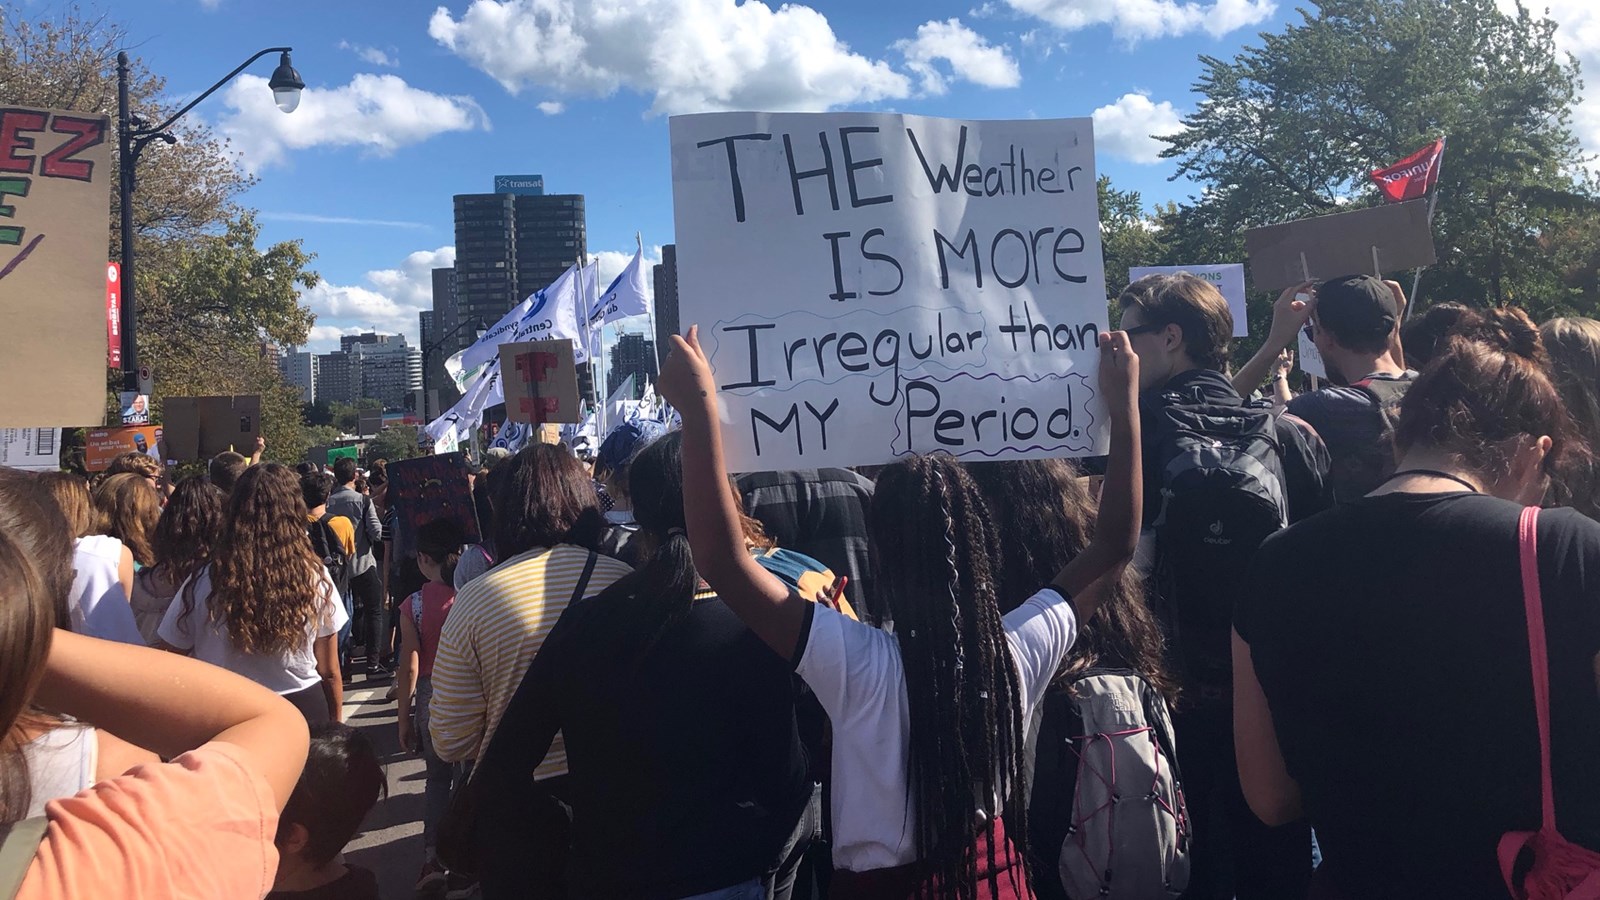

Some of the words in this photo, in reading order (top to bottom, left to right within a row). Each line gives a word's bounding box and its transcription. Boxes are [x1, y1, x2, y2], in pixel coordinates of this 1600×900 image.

[510, 180, 542, 188] transat
[697, 126, 893, 222] THE
[906, 125, 1082, 197] Weather
[823, 228, 904, 301] IS
[721, 311, 983, 406] Irregular
[999, 301, 1100, 354] than
[751, 398, 838, 456] MY
[905, 381, 1080, 450] Period.
